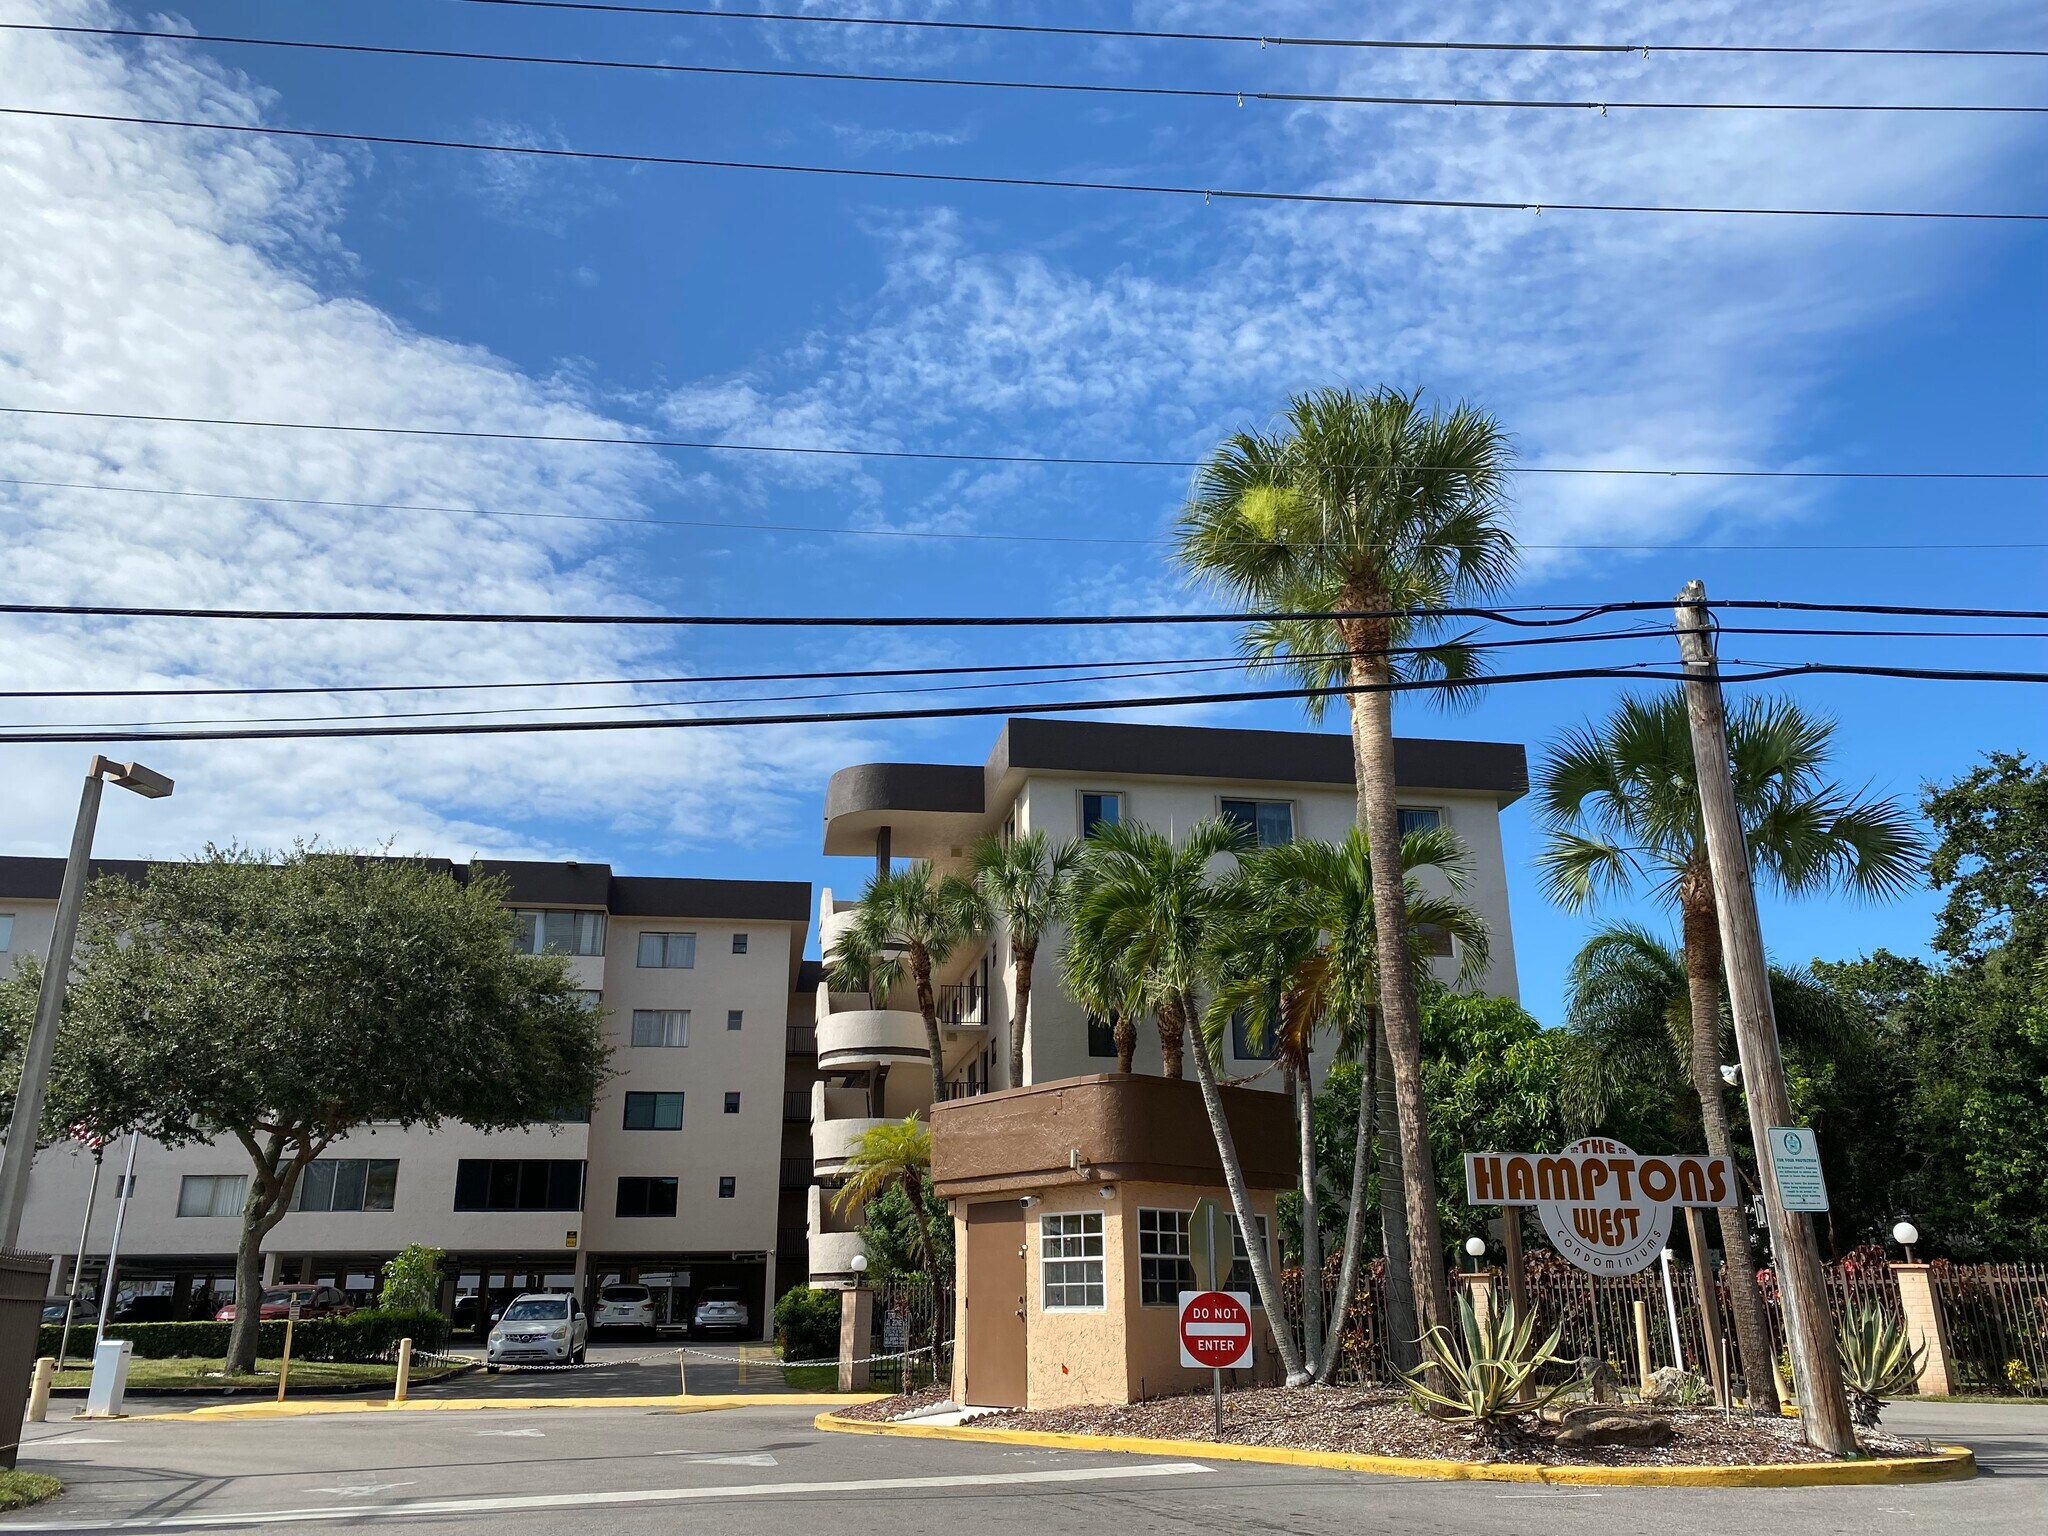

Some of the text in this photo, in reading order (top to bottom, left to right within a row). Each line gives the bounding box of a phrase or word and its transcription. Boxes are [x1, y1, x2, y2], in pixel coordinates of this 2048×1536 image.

[1580, 1139, 1616, 1154] THE
[1473, 1156, 1727, 1202] HAMPTONS
[1572, 1207, 1640, 1247] WEST
[1557, 1230, 1662, 1268] CONDOMINIUMS
[1193, 1308, 1238, 1319] DO NOT
[1198, 1340, 1235, 1351] ENTER
